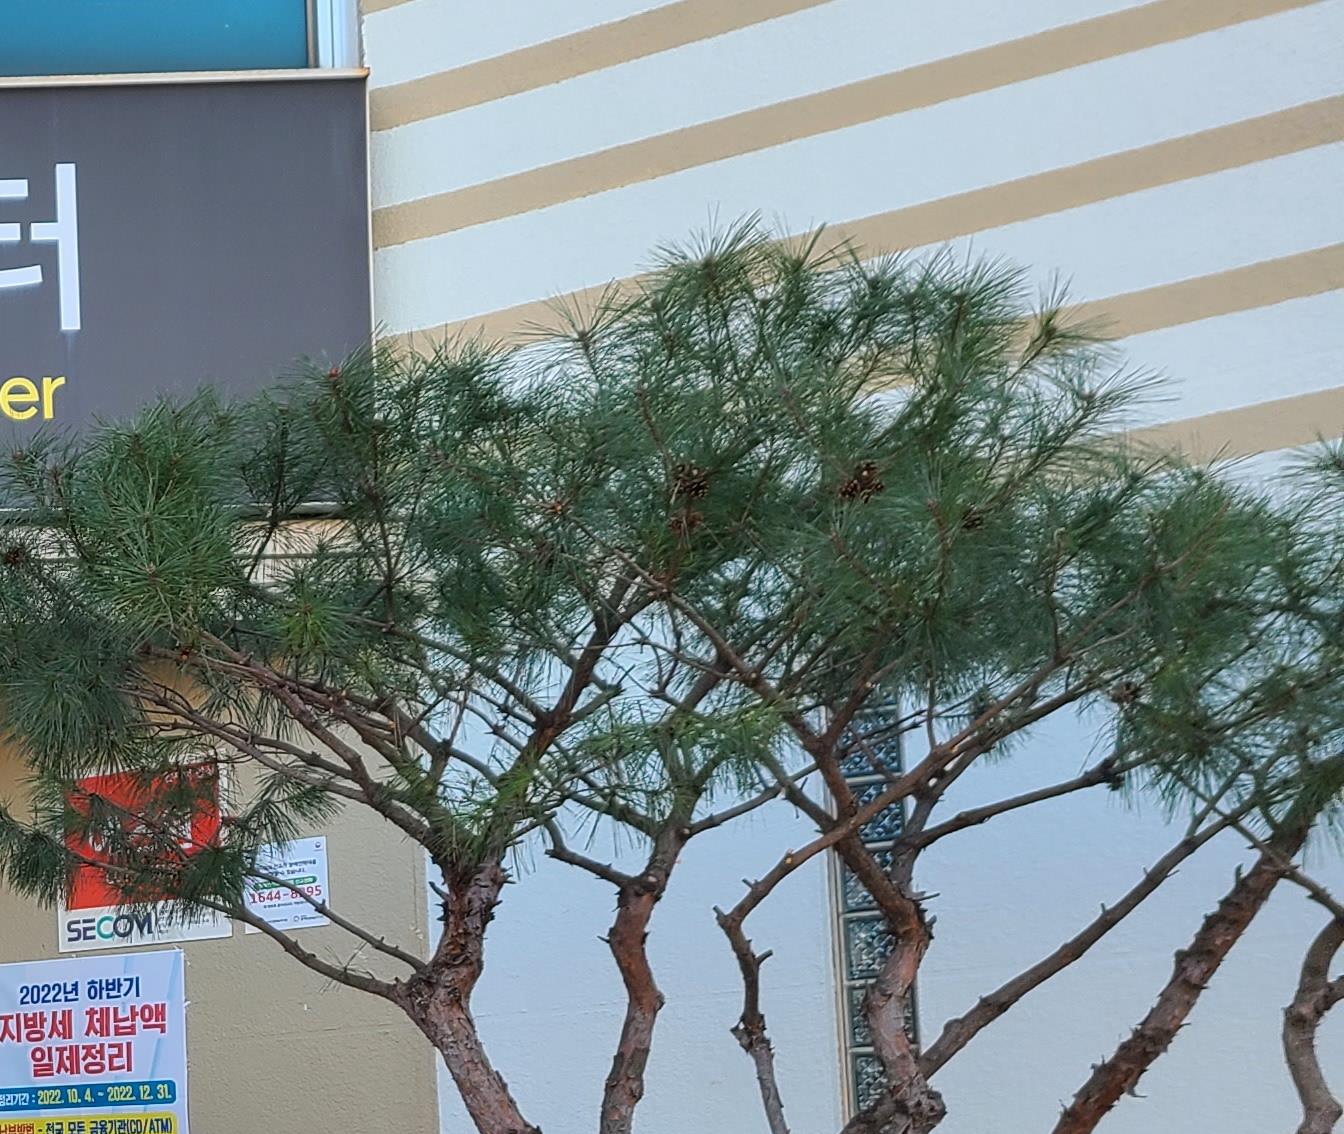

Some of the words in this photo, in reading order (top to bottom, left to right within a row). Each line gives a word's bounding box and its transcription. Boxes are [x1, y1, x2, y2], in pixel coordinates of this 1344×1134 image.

[67, 913, 155, 943] SECOM
[19, 981, 80, 1005] 2022년
[87, 976, 141, 1001] 하반기
[0, 1009, 74, 1043] 지방세
[85, 1003, 168, 1038] 체납액
[31, 1042, 133, 1078] 일제정리
